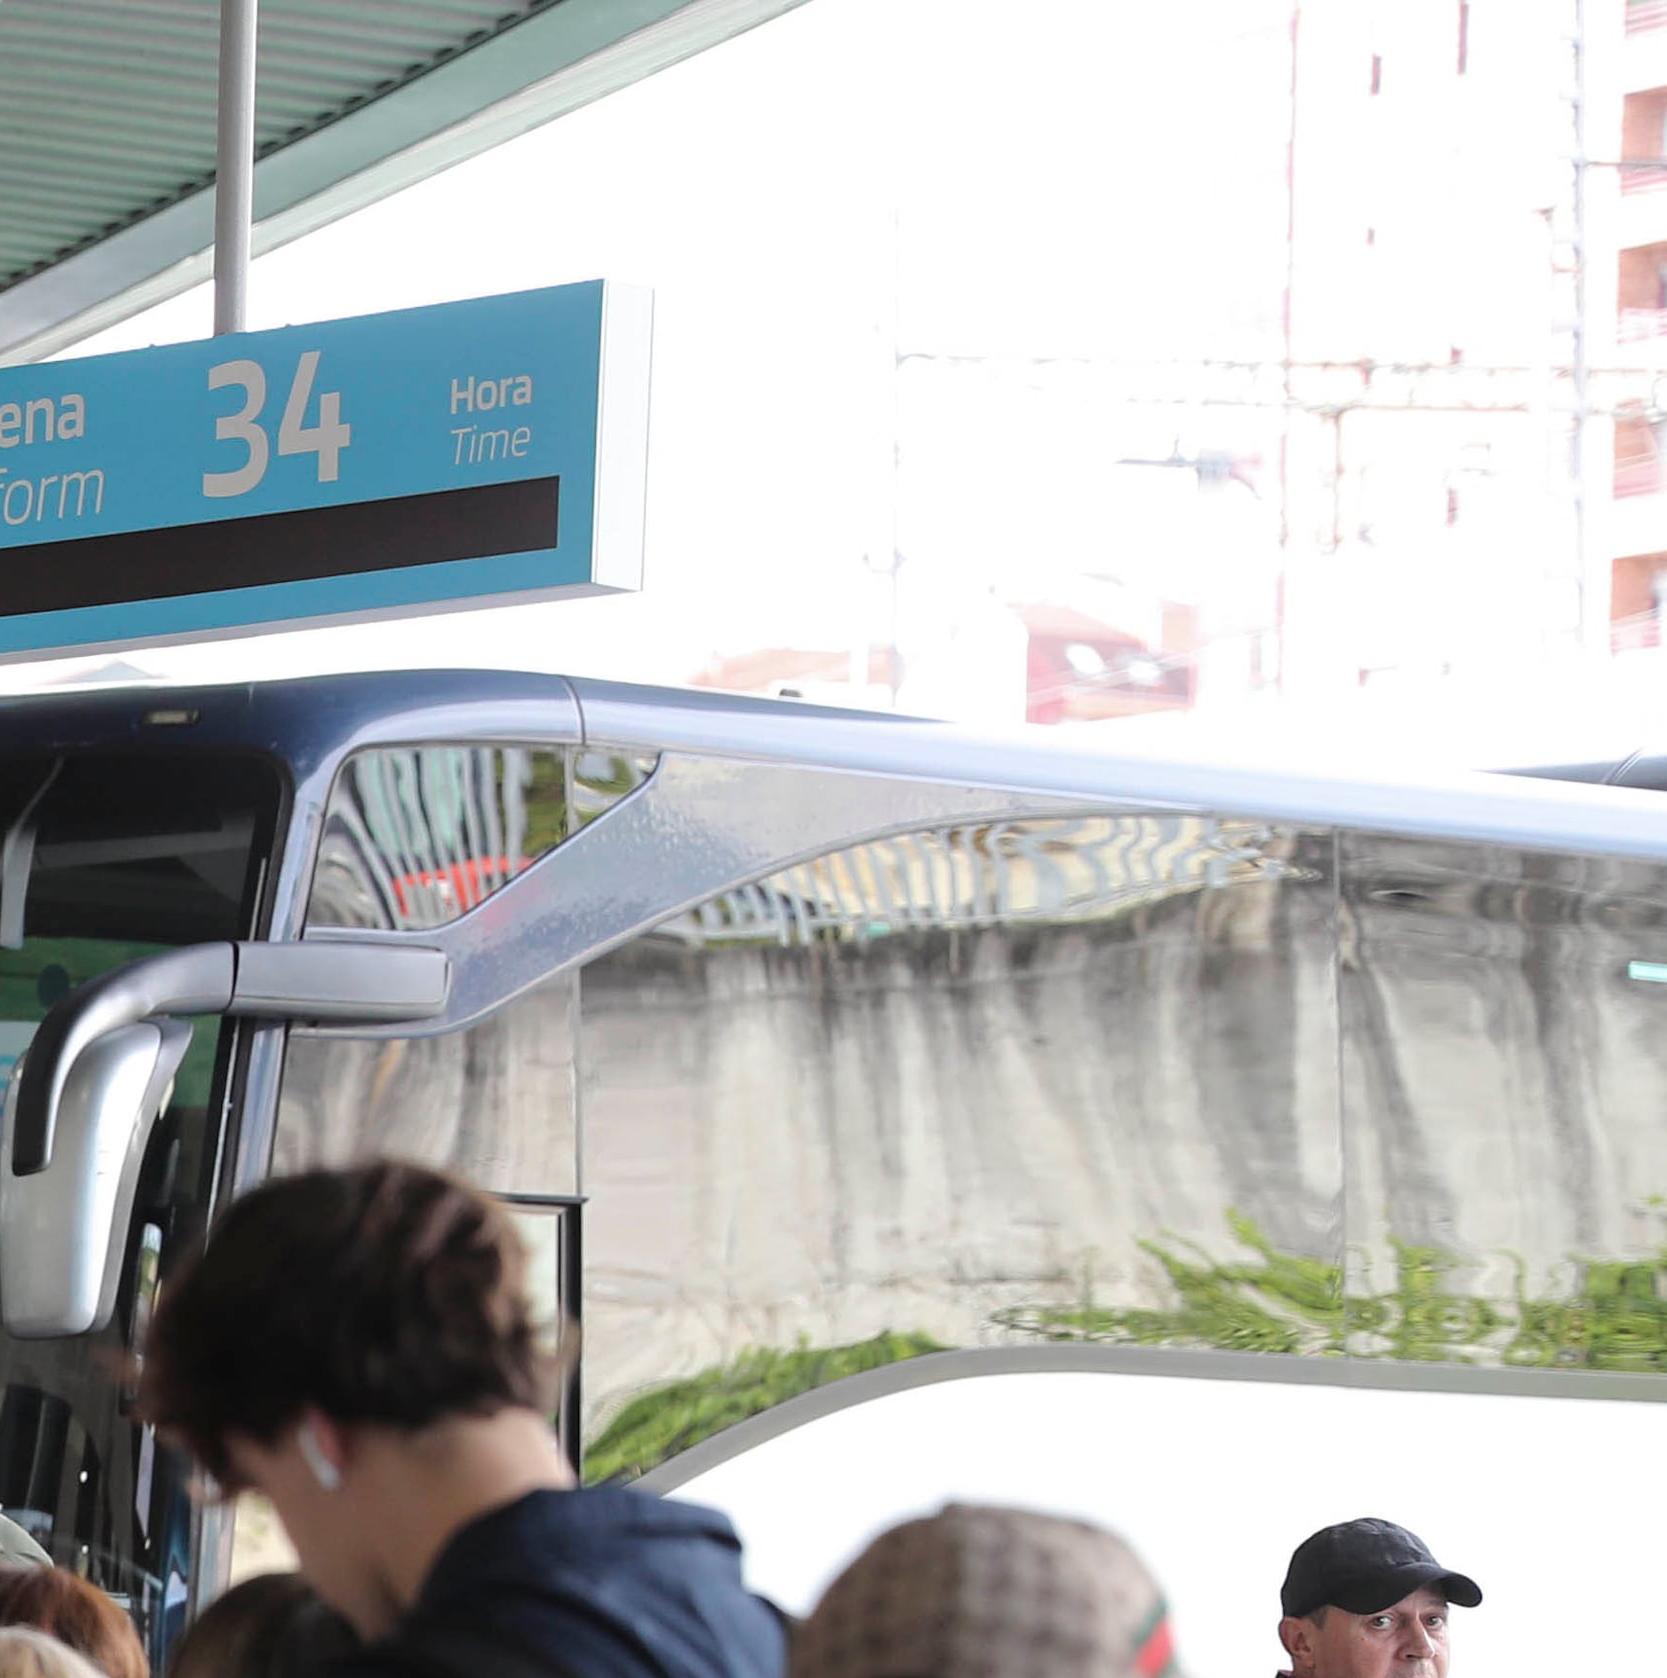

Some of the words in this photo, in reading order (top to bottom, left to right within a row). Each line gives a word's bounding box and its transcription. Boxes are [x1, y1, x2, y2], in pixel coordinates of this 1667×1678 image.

[203, 350, 351, 498] 34
[450, 372, 532, 415] Hora
[451, 422, 532, 467] Time
